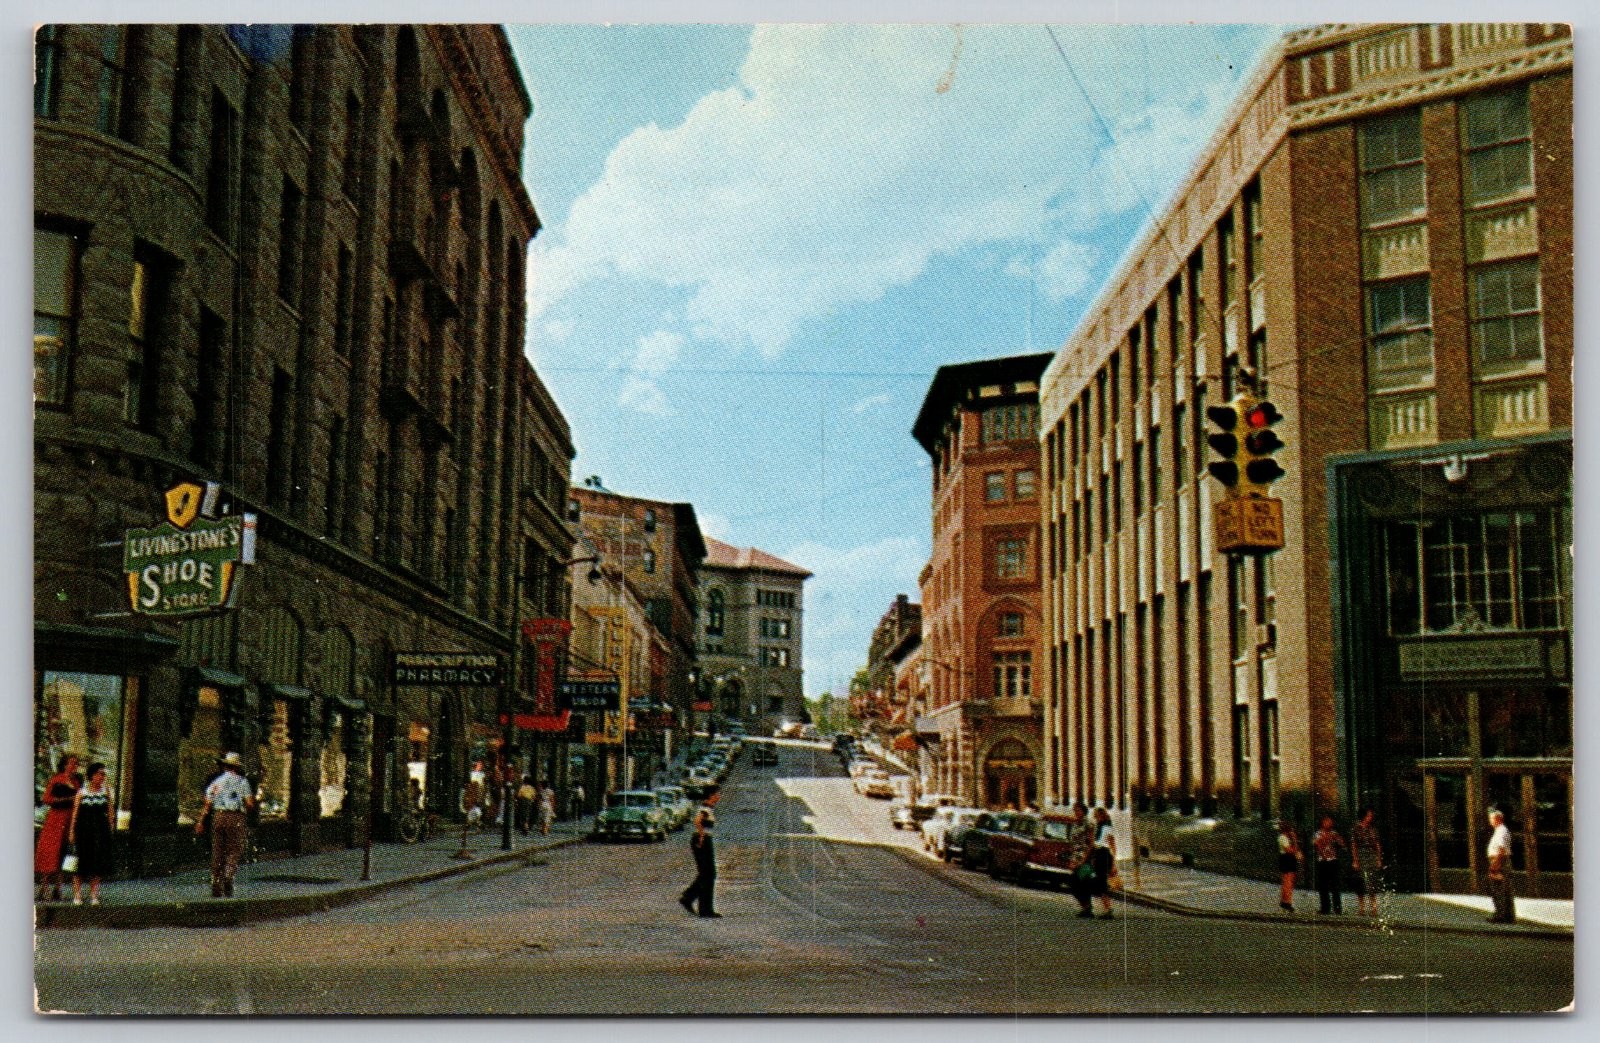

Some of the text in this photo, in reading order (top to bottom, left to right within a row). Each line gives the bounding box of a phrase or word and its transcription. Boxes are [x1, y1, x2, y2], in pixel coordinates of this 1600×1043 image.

[130, 524, 241, 558] LIVINGSTONE'S
[140, 559, 214, 608] SHOE
[162, 592, 208, 610] STORE
[395, 669, 495, 683] PHARMACY
[562, 684, 618, 694] WESTERN
